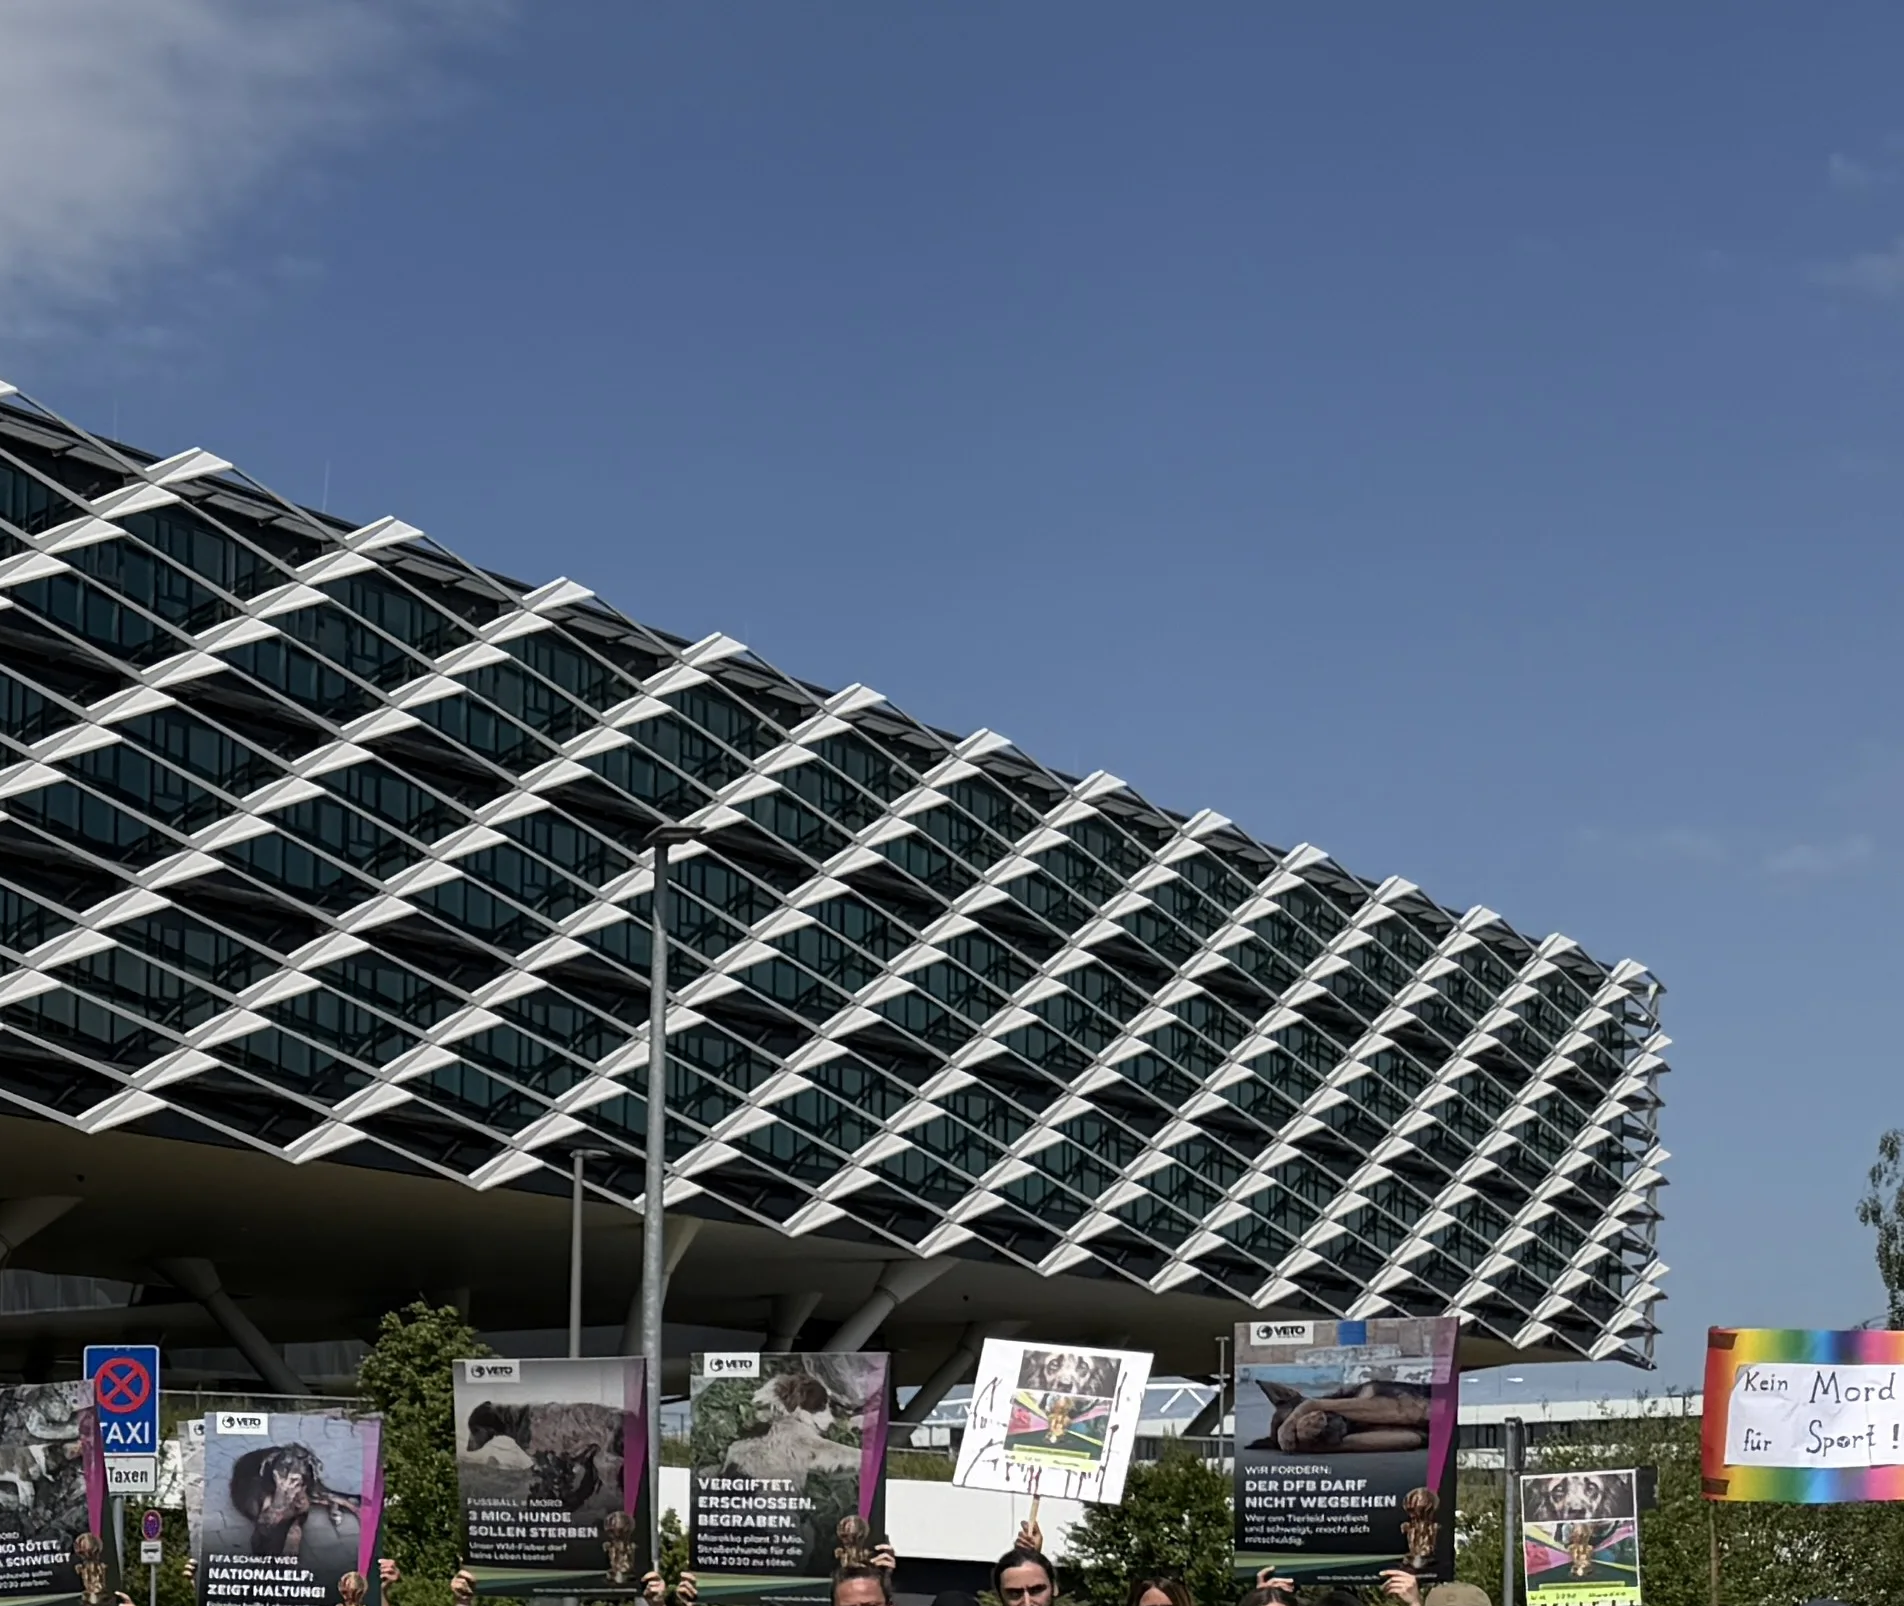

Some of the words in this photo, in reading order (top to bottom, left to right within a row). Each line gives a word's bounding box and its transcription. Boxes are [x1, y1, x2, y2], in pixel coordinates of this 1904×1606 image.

[1744, 1371, 1788, 1392] Kein
[1809, 1371, 1896, 1403] Mord
[99, 1421, 150, 1444] TAXI
[1744, 1428, 1772, 1452] für
[1806, 1419, 1876, 1457] Sport
[108, 1467, 148, 1483] Taxen
[1245, 1466, 1268, 1474] WIR
[698, 1478, 795, 1492] VERGIFTET.
[1245, 1480, 1279, 1491] DER
[1283, 1480, 1317, 1491] DFB
[1320, 1479, 1367, 1491] DARF
[698, 1496, 816, 1510] ERSCHOSSEN.
[1245, 1496, 1296, 1508] NICHT
[1300, 1495, 1396, 1508] WEGSEHEN
[481, 1511, 515, 1522] MIO.
[519, 1512, 572, 1523] HUNDE
[698, 1514, 796, 1528] BEGRABEN.
[468, 1526, 526, 1537] SOLLEN
[529, 1526, 599, 1538] STERBEN
[18, 1540, 61, 1552] TÖTET,
[6, 1553, 72, 1567] SCHWEIGT
[207, 1584, 250, 1596] ZEIGT
[253, 1586, 326, 1598] HALTUNG!
